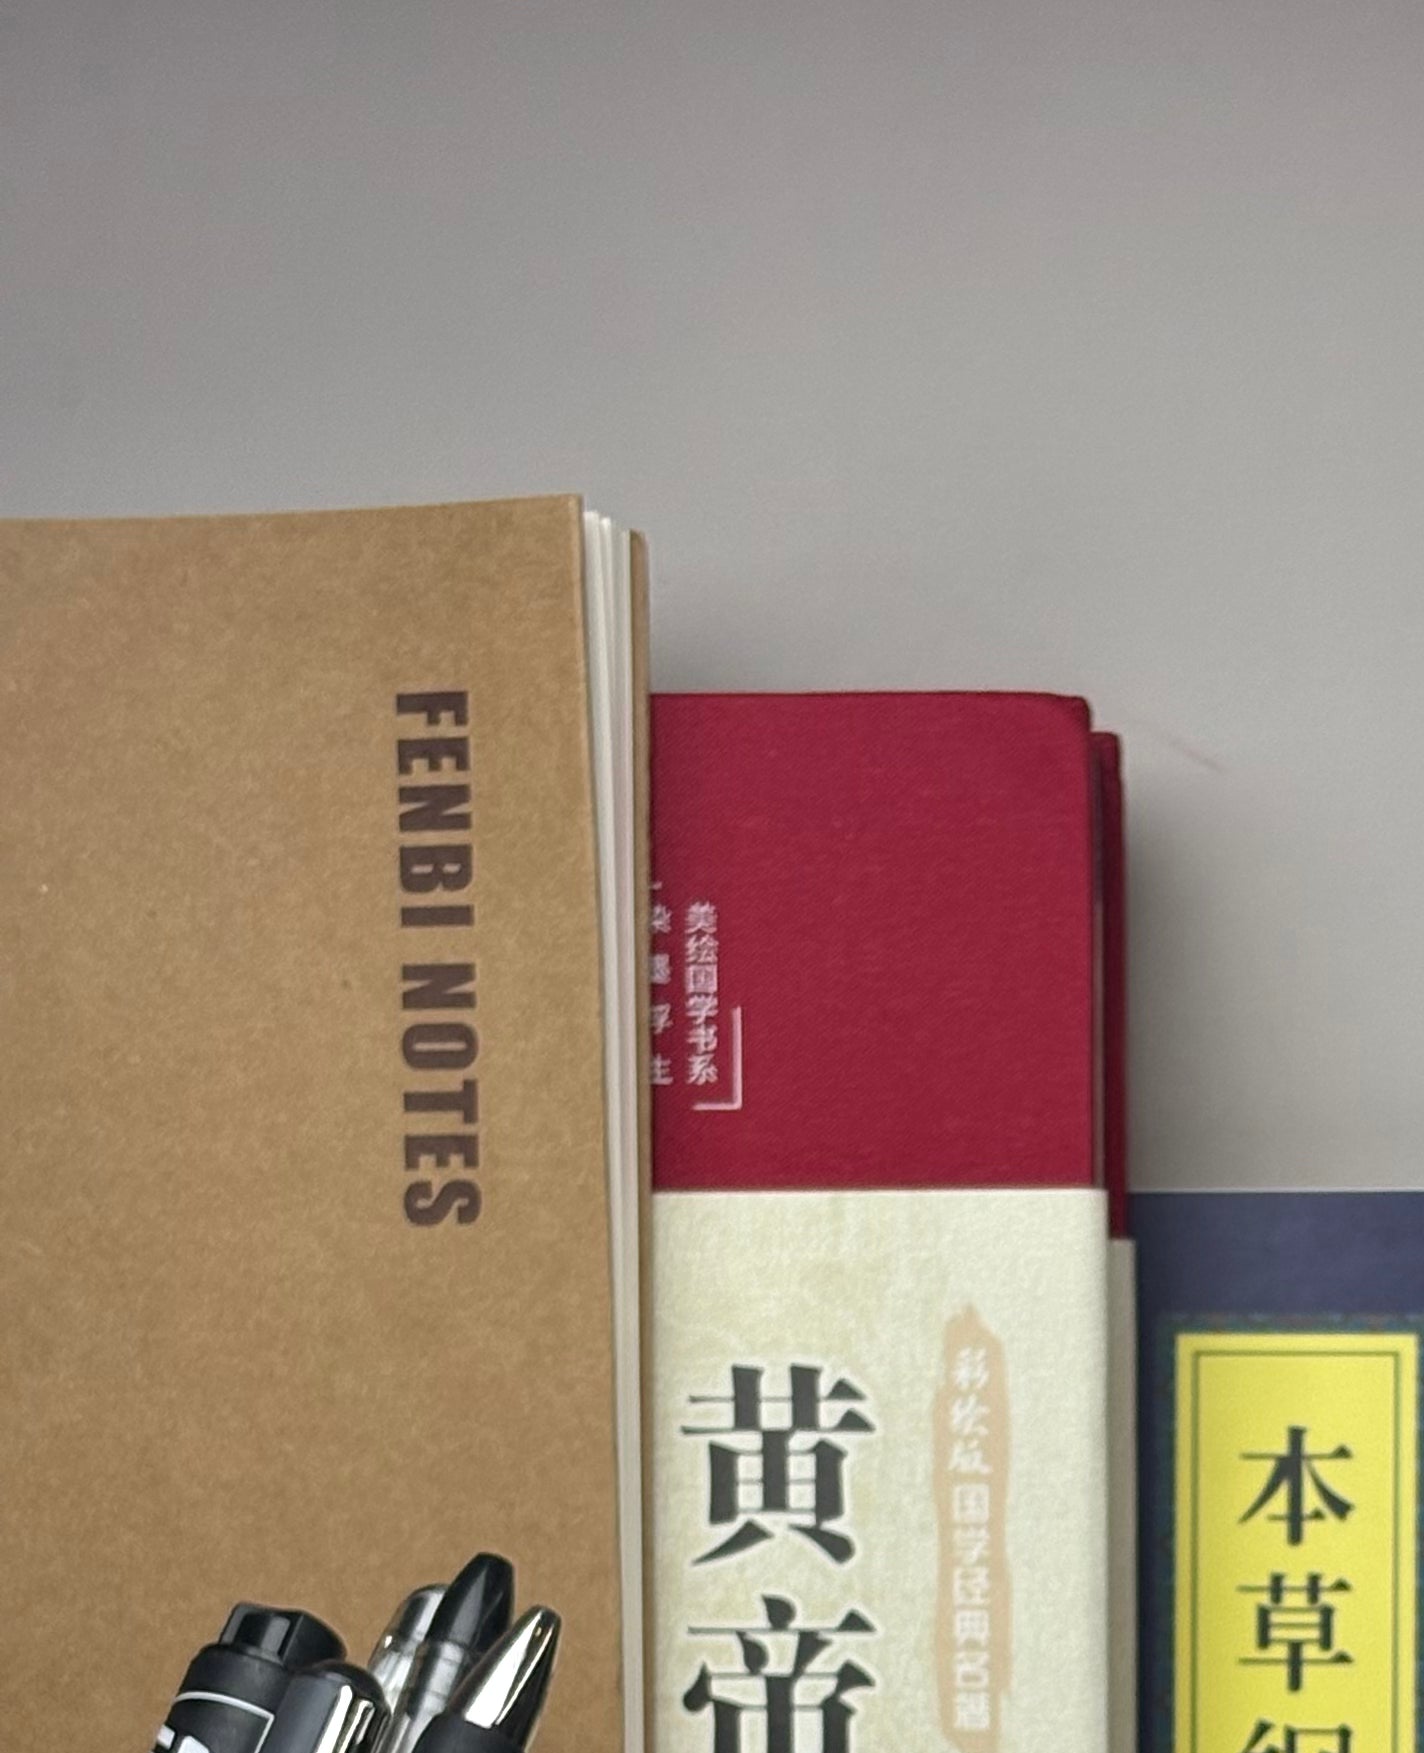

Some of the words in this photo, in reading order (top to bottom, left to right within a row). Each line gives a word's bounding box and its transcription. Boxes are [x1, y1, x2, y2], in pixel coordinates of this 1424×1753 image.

[396, 690, 475, 928] FENBI
[401, 962, 482, 1227] NOTES
[685, 901, 719, 1085] 美绘国学书系
